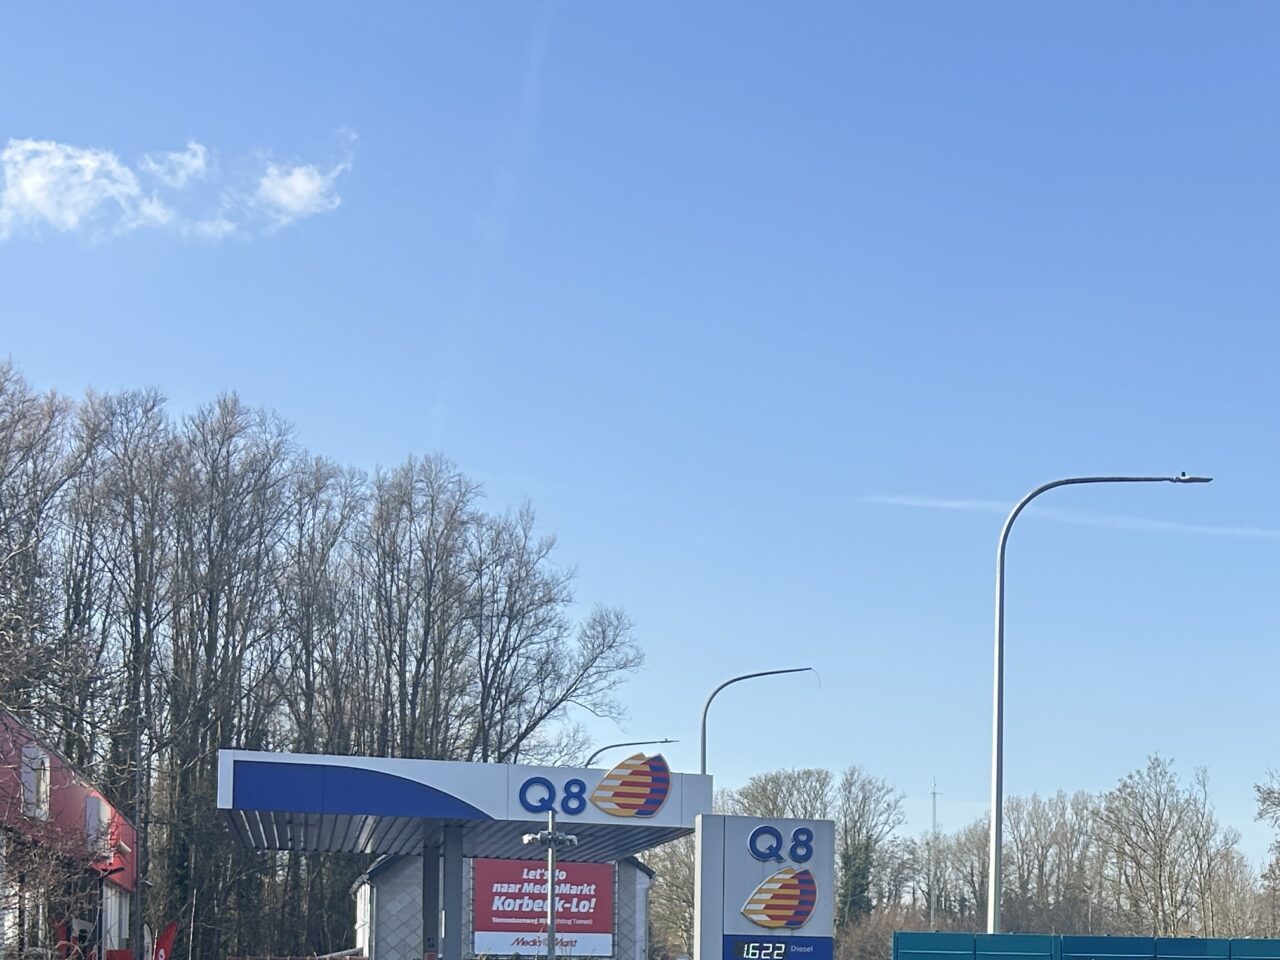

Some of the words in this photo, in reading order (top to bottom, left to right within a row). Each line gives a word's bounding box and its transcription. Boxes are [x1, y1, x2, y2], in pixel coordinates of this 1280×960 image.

[519, 776, 587, 815] Q8
[748, 825, 814, 863] Q8
[492, 883, 521, 893] naar
[522, 882, 596, 894] MedaMarkt
[790, 945, 813, 953] Diesel
